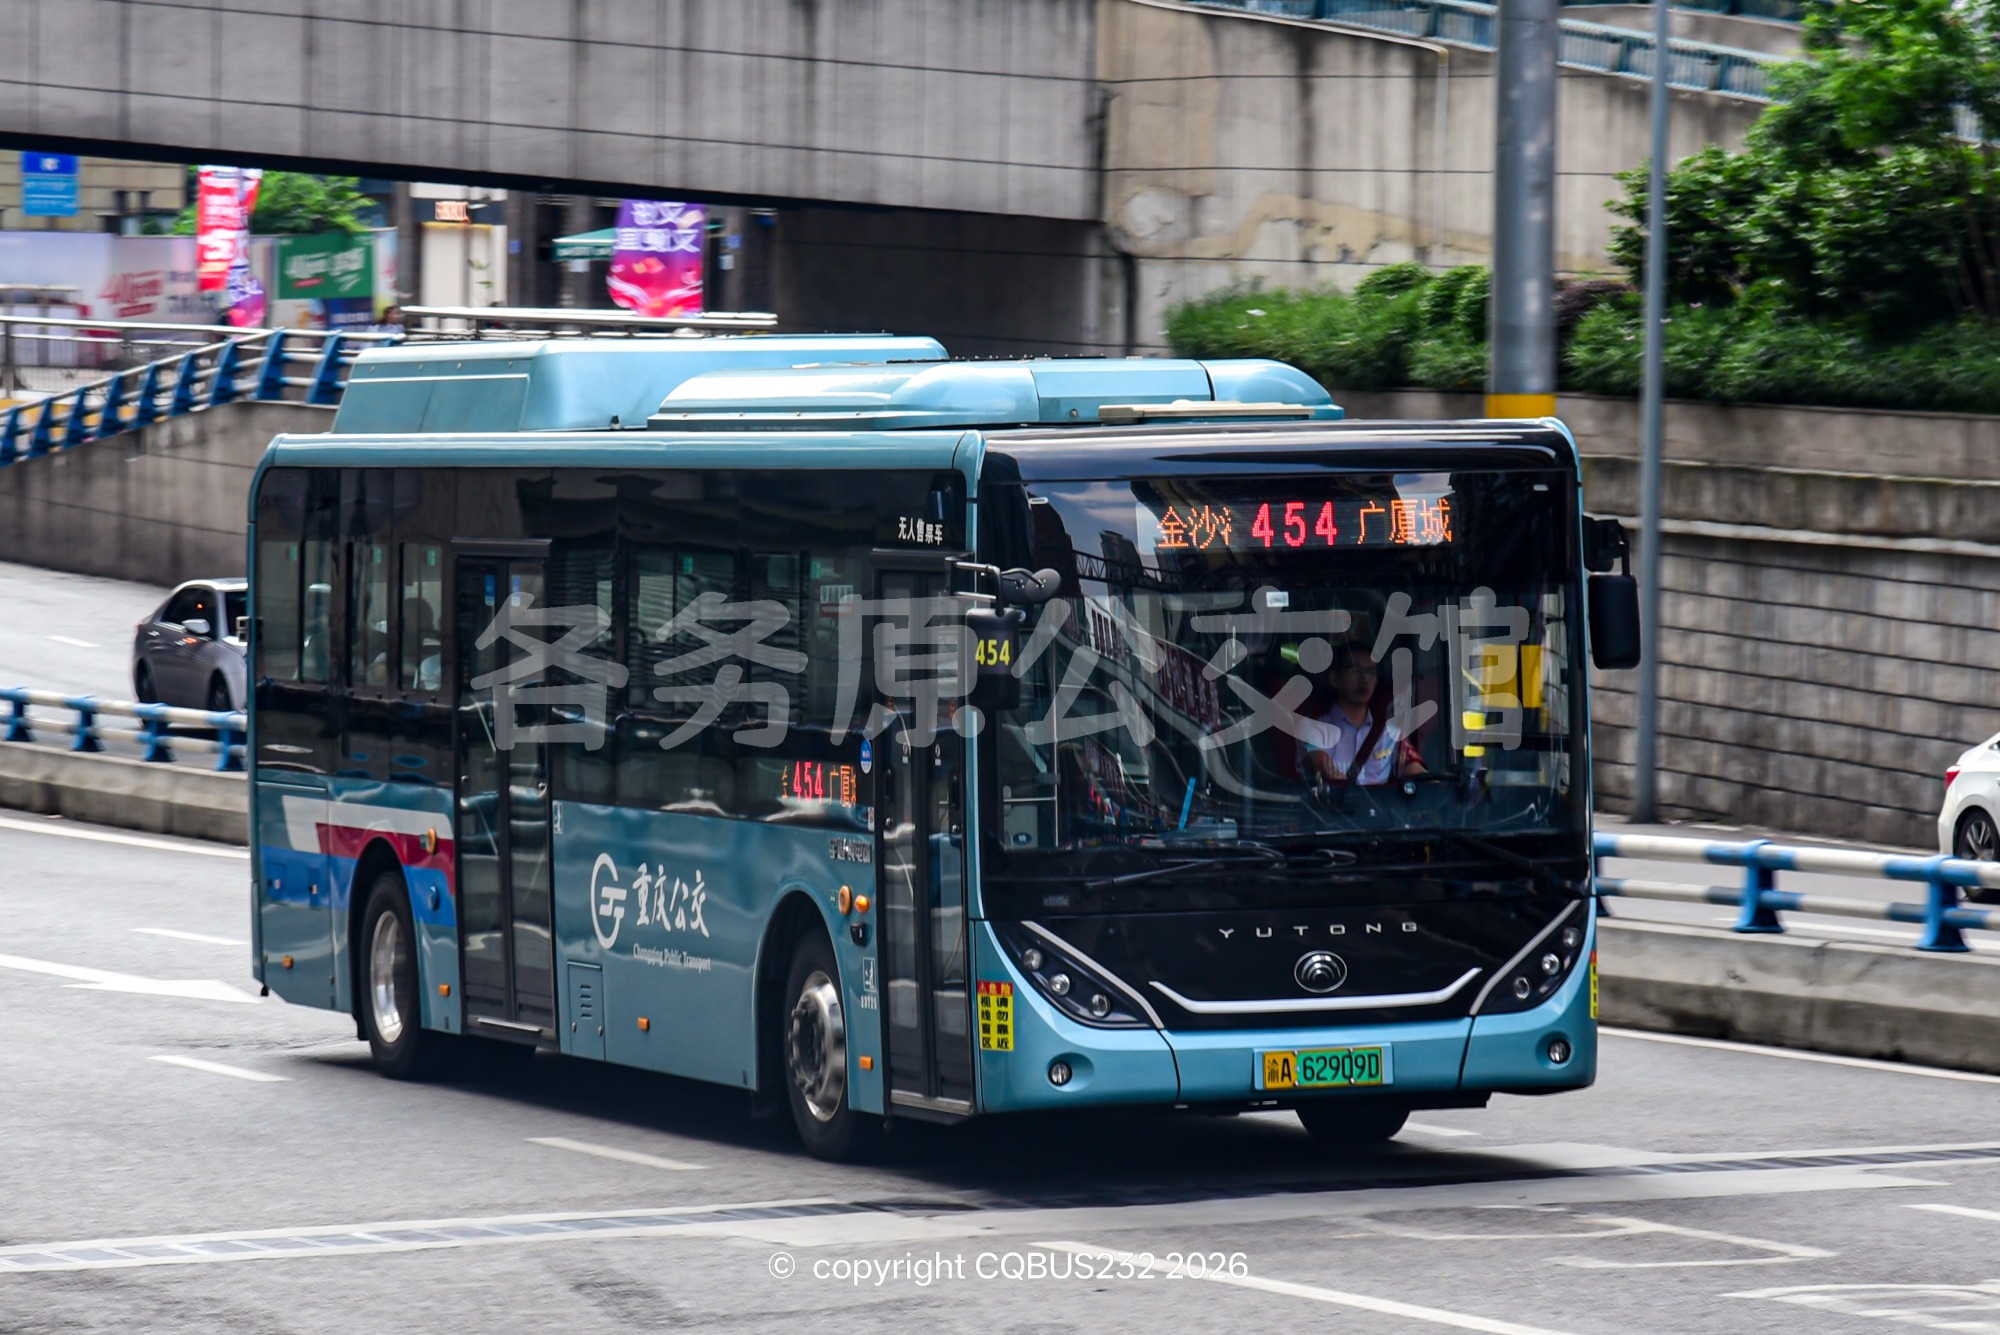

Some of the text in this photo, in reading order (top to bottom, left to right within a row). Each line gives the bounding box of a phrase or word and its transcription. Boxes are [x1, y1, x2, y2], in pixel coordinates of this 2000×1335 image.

[898, 516, 943, 546] 无人售票车
[1252, 501, 1337, 548] 454
[1357, 498, 1453, 545] 广厦城
[975, 639, 1011, 666] 454
[793, 760, 825, 805] 454
[632, 862, 710, 938] 重庆公交
[1218, 921, 1418, 939] YUTONG
[664, 947, 682, 967] Public
[682, 950, 711, 974] Transport
[1267, 1053, 1380, 1083] 渝A 62909D
